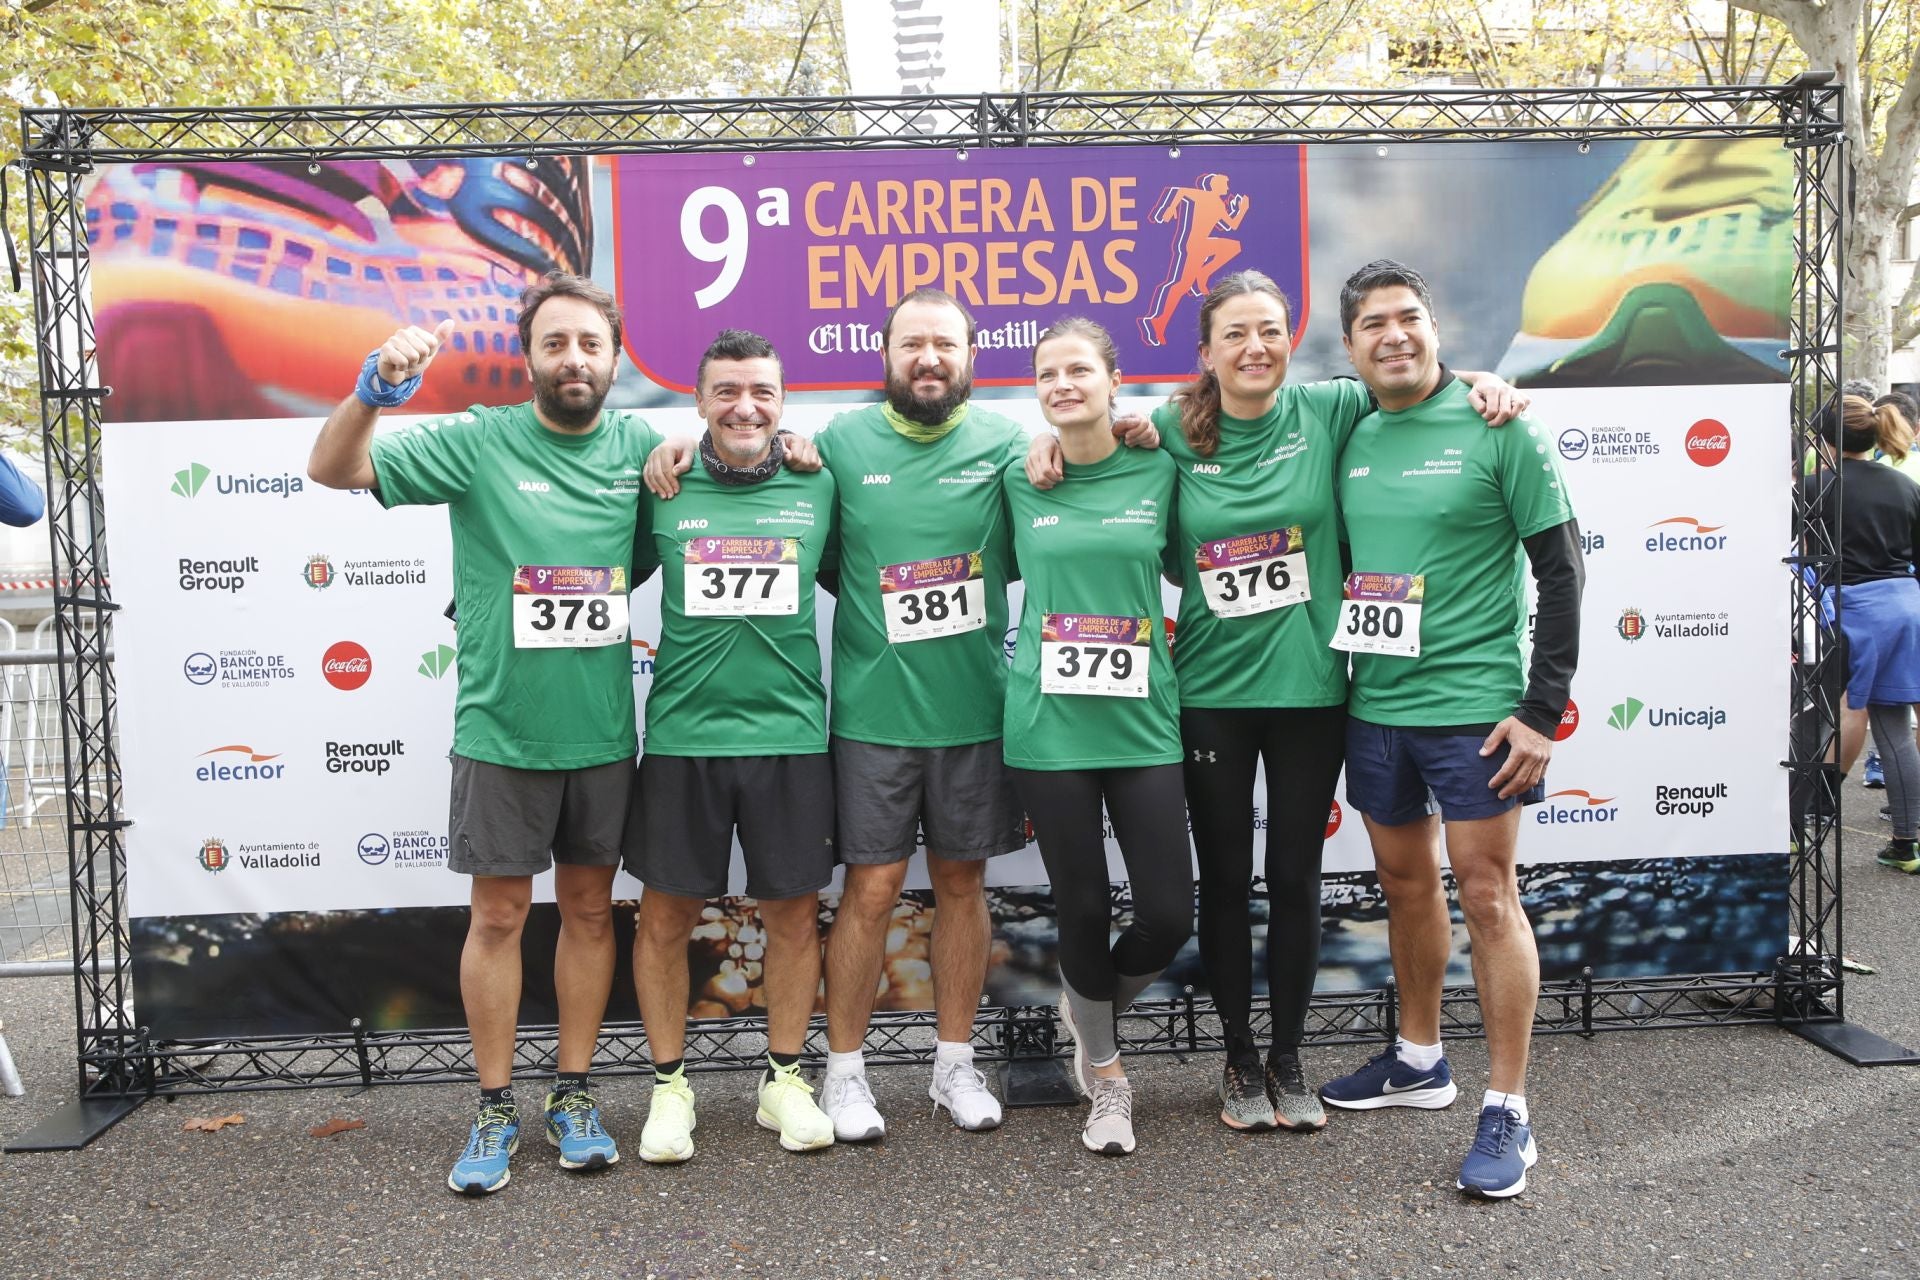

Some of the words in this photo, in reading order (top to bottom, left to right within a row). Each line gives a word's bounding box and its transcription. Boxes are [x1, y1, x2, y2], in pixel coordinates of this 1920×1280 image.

[804, 177, 1056, 237] CARRERA
[1071, 176, 1138, 231] DE
[808, 239, 1139, 310] EMPRESAS
[973, 320, 1050, 350] astill
[1590, 431, 1632, 444] BANCO
[1635, 431, 1652, 443] DE
[1687, 435, 1728, 450] Coca-Cola
[1591, 443, 1661, 456] ALIMENTOS
[1191, 463, 1221, 475] JAKO
[1348, 466, 1370, 478] JAKO
[217, 473, 303, 498] Unicaja
[517, 481, 550, 493] JAKO
[862, 474, 891, 485] JAKO
[677, 519, 709, 531] JAKO
[1032, 515, 1060, 528] JAKO
[1258, 534, 1268, 542] DE
[1646, 531, 1726, 552] elecnor
[721, 546, 763, 554] EMPRESAS
[1228, 542, 1269, 556] EMPRESAS
[179, 557, 258, 576] Renault
[342, 558, 411, 570] Ayuntamiento
[414, 558, 426, 567] de
[943, 559, 952, 567] DE
[345, 570, 425, 585] Valladolid
[553, 576, 593, 585] EMPRESAS
[913, 567, 953, 579] EMPRESAS
[180, 575, 244, 593] Group
[701, 567, 780, 599] 377
[1216, 560, 1291, 602] 376
[898, 585, 968, 625] 381
[531, 599, 611, 631] 378
[1110, 618, 1119, 626] DE
[1347, 604, 1404, 638] 380
[1655, 612, 1716, 624] Ayuntamiento
[1718, 611, 1729, 620] de
[1078, 624, 1119, 635] EMPRESAS
[1654, 623, 1730, 639] Valladolid
[220, 655, 264, 668] BANCO
[267, 655, 285, 667] DE
[325, 658, 369, 674] Coca-Cola
[1057, 646, 1133, 680] 379
[221, 667, 295, 681] ALIMENTOS
[1649, 706, 1726, 730] Unicaja
[326, 740, 404, 757] Renault
[196, 760, 284, 781] elecnor
[326, 758, 390, 776] Group
[1657, 783, 1727, 801] Renault
[1537, 803, 1618, 824] elecnor
[1656, 799, 1714, 818] Group
[239, 844, 307, 855] Ayuntamiento
[393, 836, 436, 848] BANCO
[440, 836, 449, 847] D
[240, 853, 320, 868] Valladolid
[394, 848, 450, 860] ALIMENT
